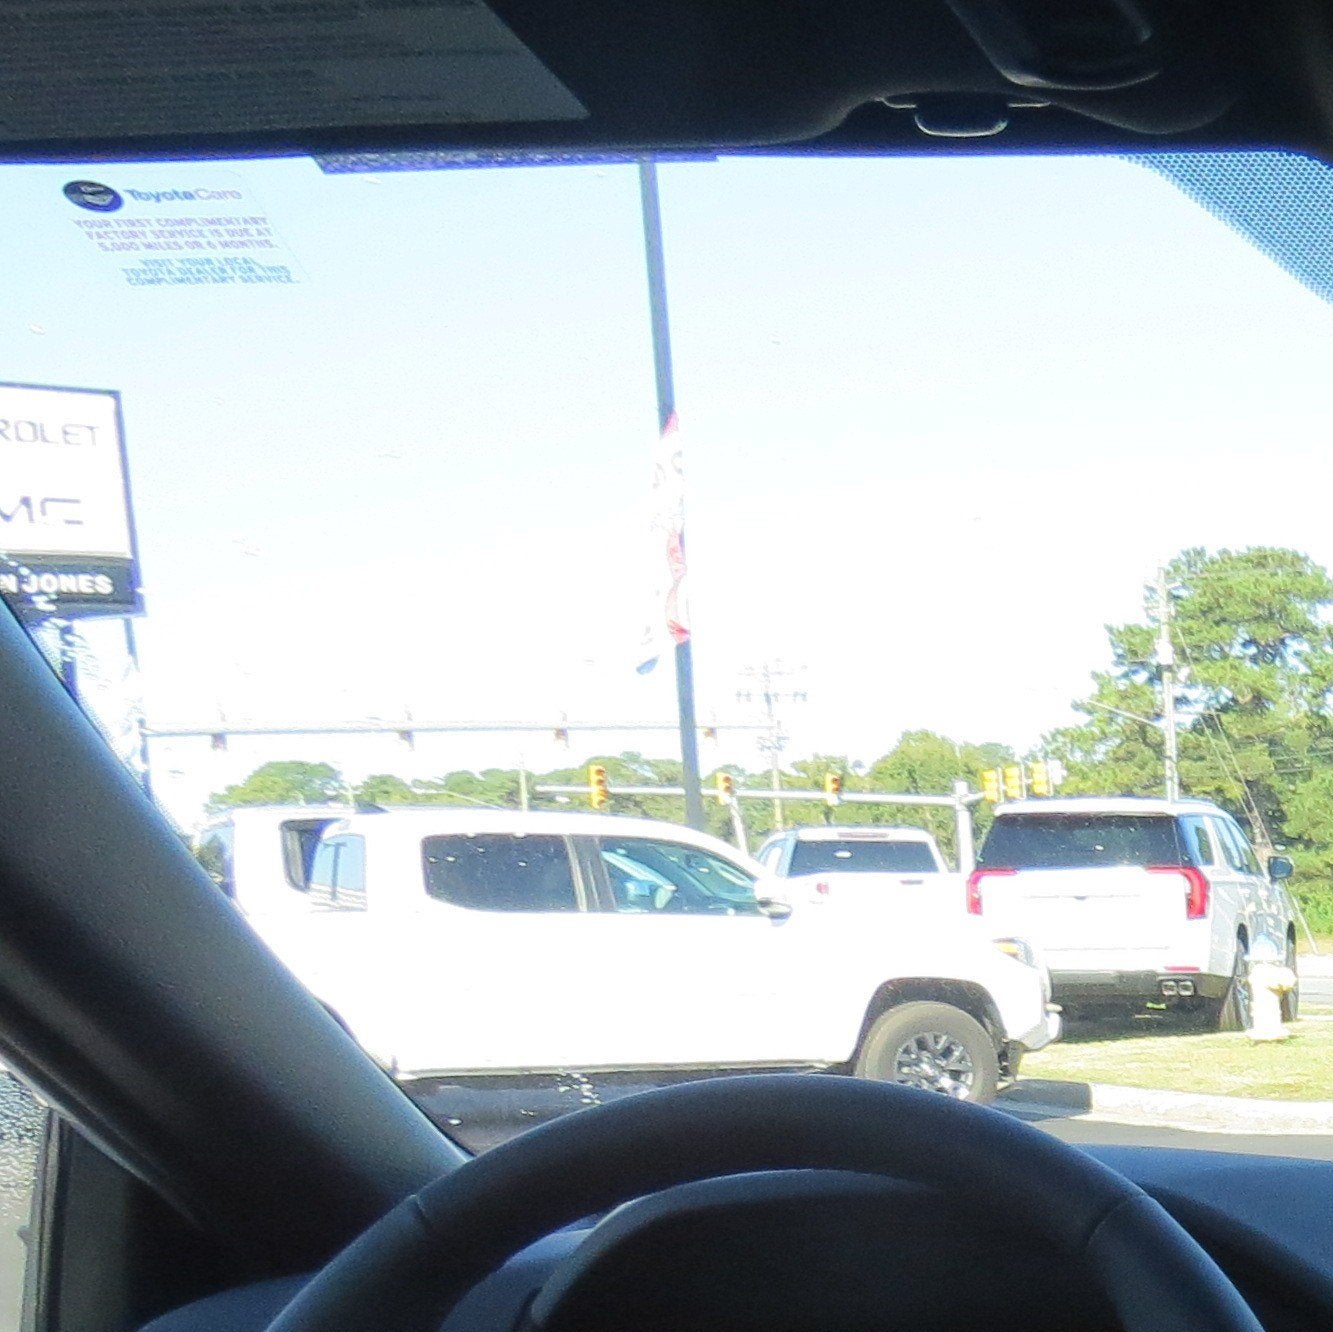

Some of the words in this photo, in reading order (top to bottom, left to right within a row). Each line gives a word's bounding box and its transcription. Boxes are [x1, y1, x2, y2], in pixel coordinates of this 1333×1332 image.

[123, 188, 243, 203] ToyotaCare
[115, 217, 153, 228] FIRST
[156, 216, 269, 228] COMPLIMENTARY
[152, 229, 205, 239] SERVICE
[143, 241, 182, 251] MILES
[21, 573, 115, 596] JONES
